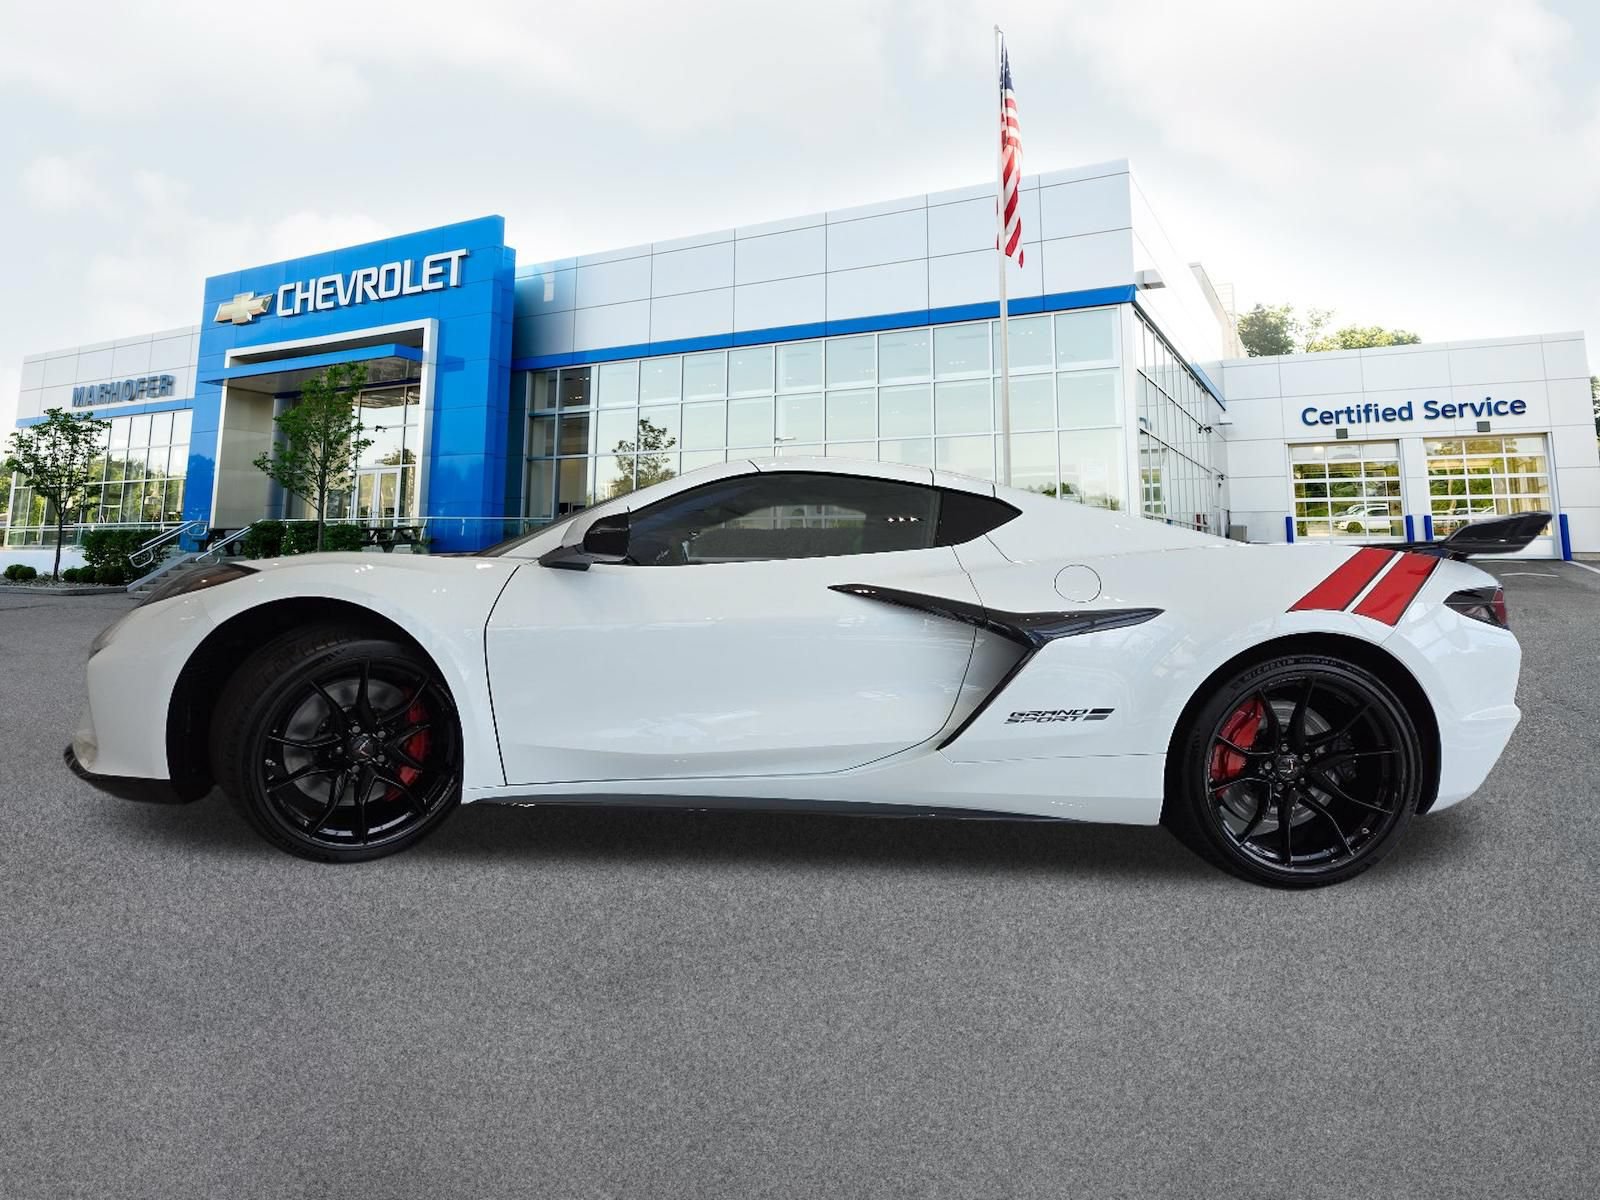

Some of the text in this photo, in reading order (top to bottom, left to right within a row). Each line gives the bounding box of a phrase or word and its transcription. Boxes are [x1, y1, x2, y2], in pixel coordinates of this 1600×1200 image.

[276, 248, 469, 317] CHEVROLET
[72, 374, 175, 407] MARHOFER
[1301, 397, 1527, 426] Certified Service
[1004, 715, 1084, 724] SPORT
[1009, 708, 1089, 718] GRAND
